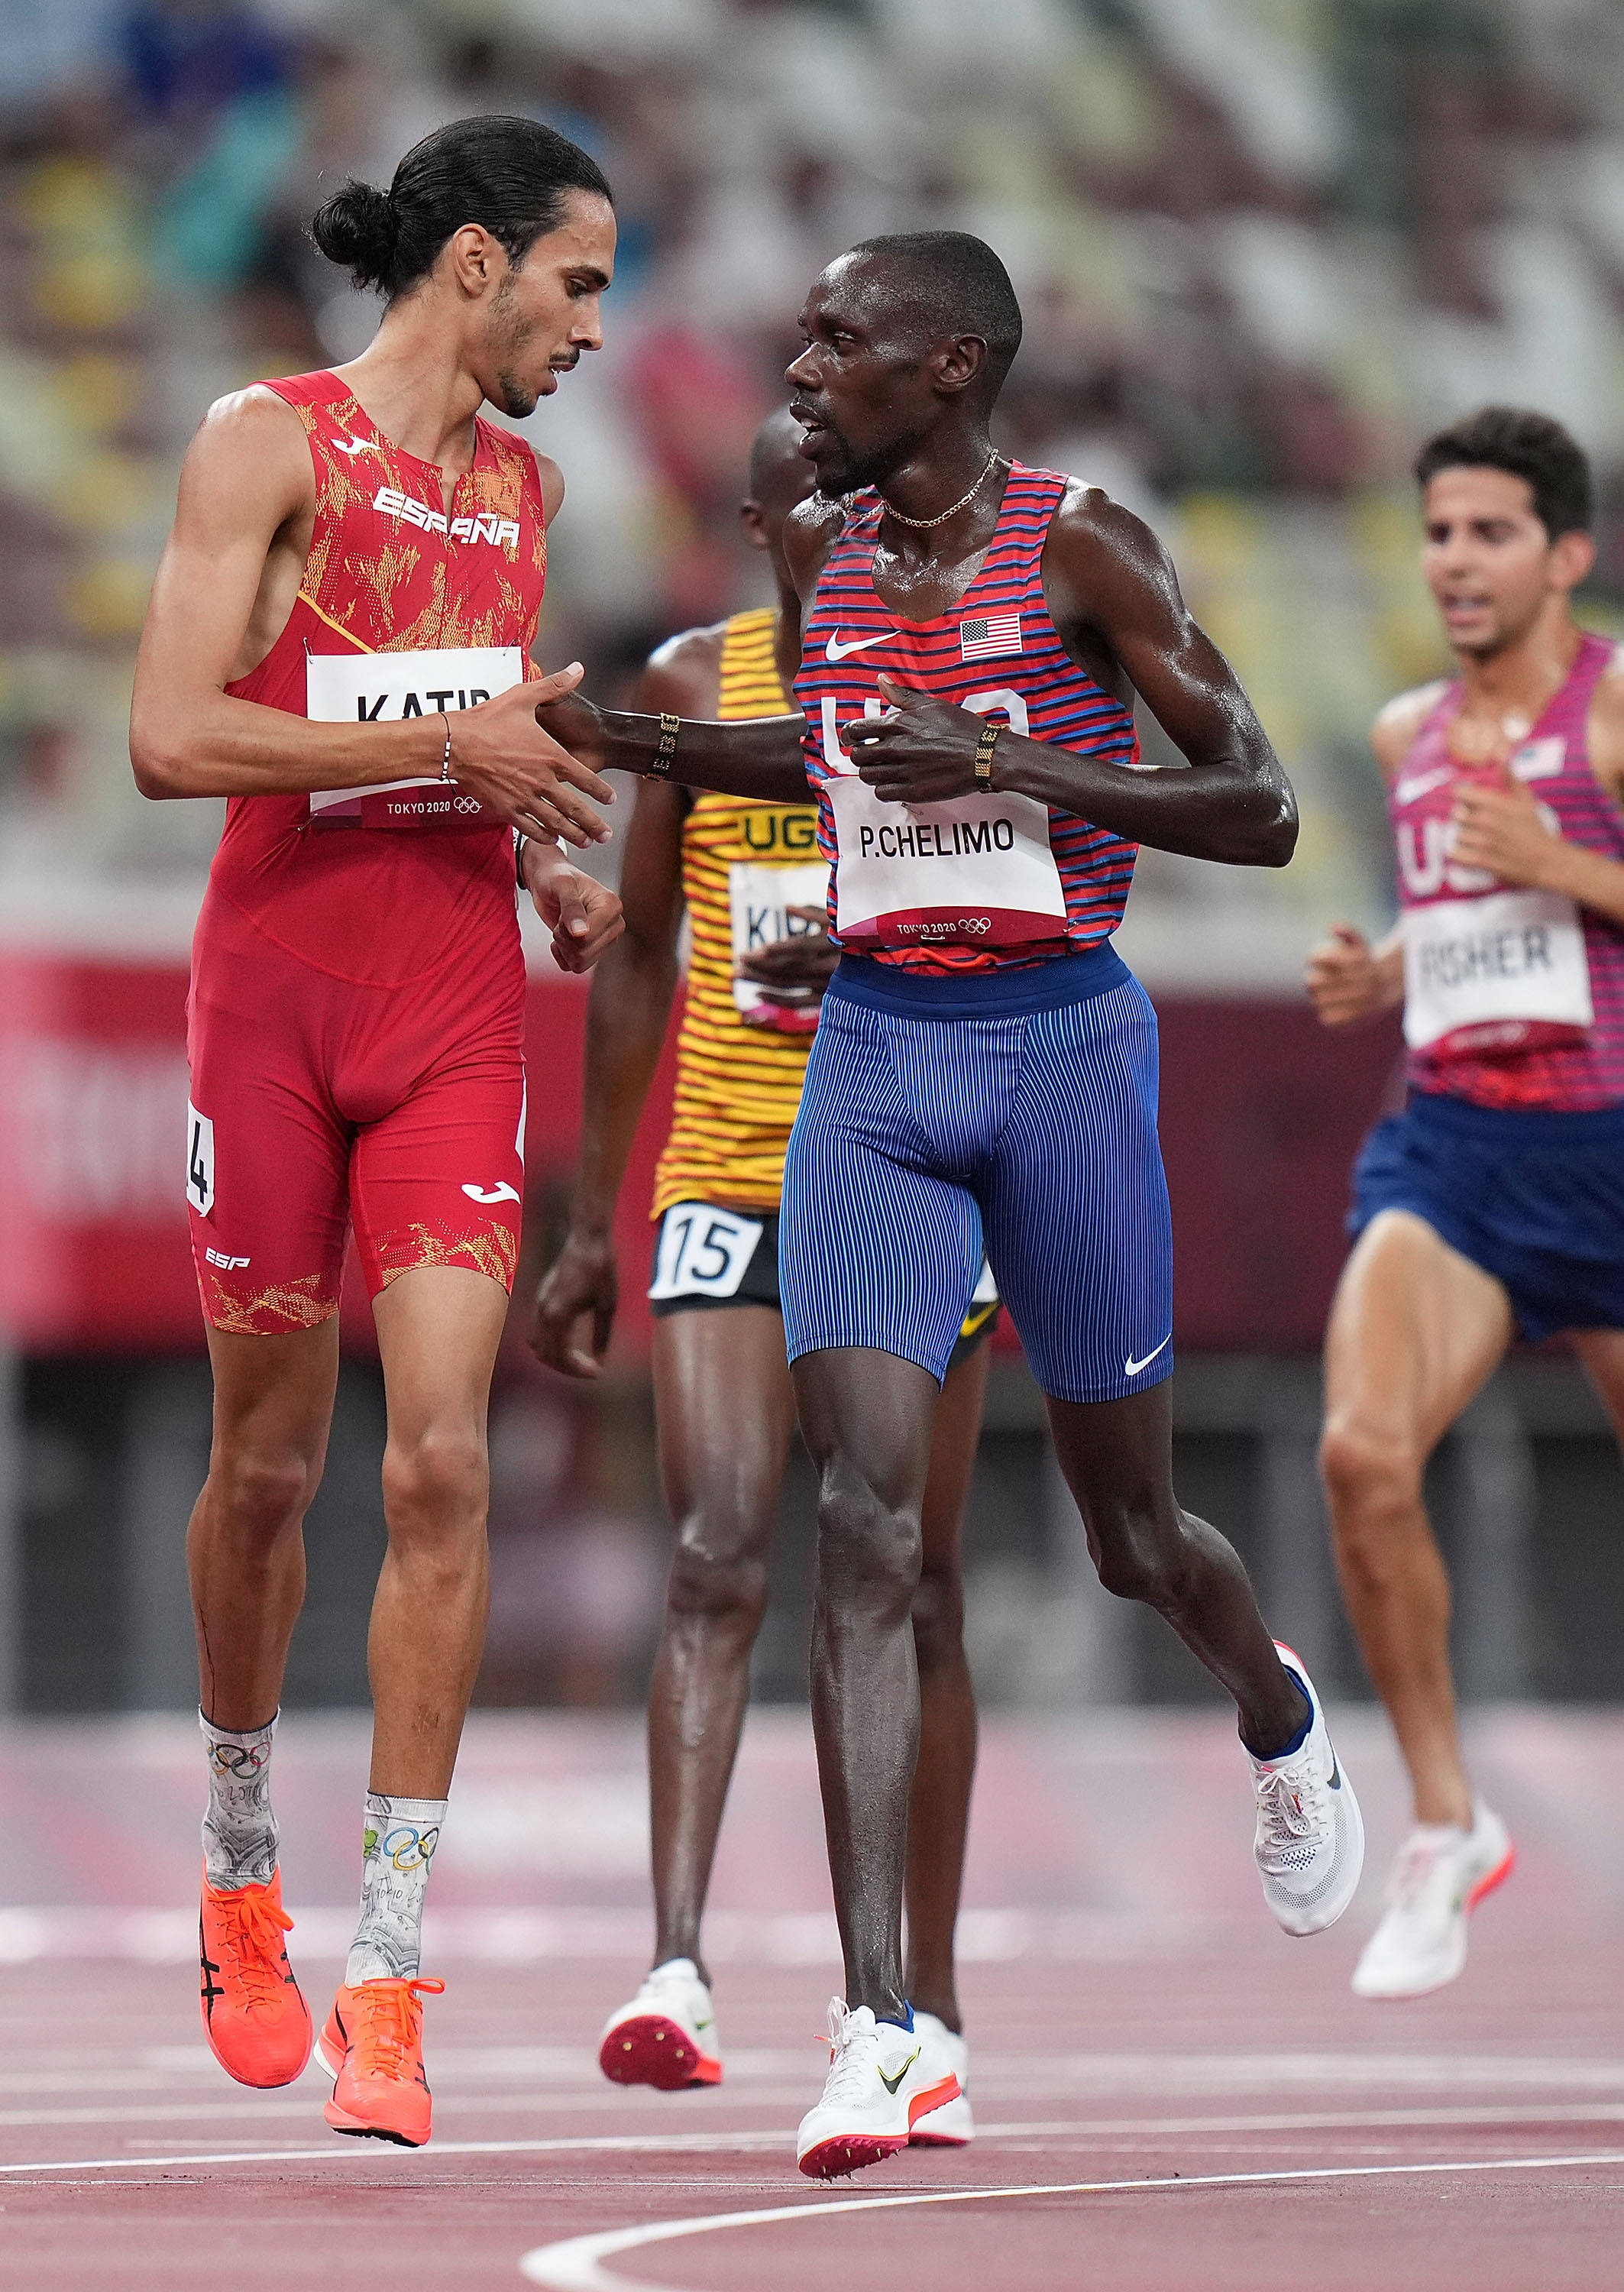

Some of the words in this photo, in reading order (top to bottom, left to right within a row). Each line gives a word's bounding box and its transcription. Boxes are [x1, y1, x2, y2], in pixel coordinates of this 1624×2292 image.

[373, 486, 520, 548] ESPAÑA
[387, 802, 425, 814] TOKYO
[426, 801, 451, 813] 2020
[860, 818, 1014, 858] P.CHELIMO
[897, 924, 930, 934] TOKYO
[931, 922, 956, 933] 2020
[190, 1120, 209, 1205] 4
[205, 1247, 251, 1271] ESP
[676, 1218, 739, 1285] 15
